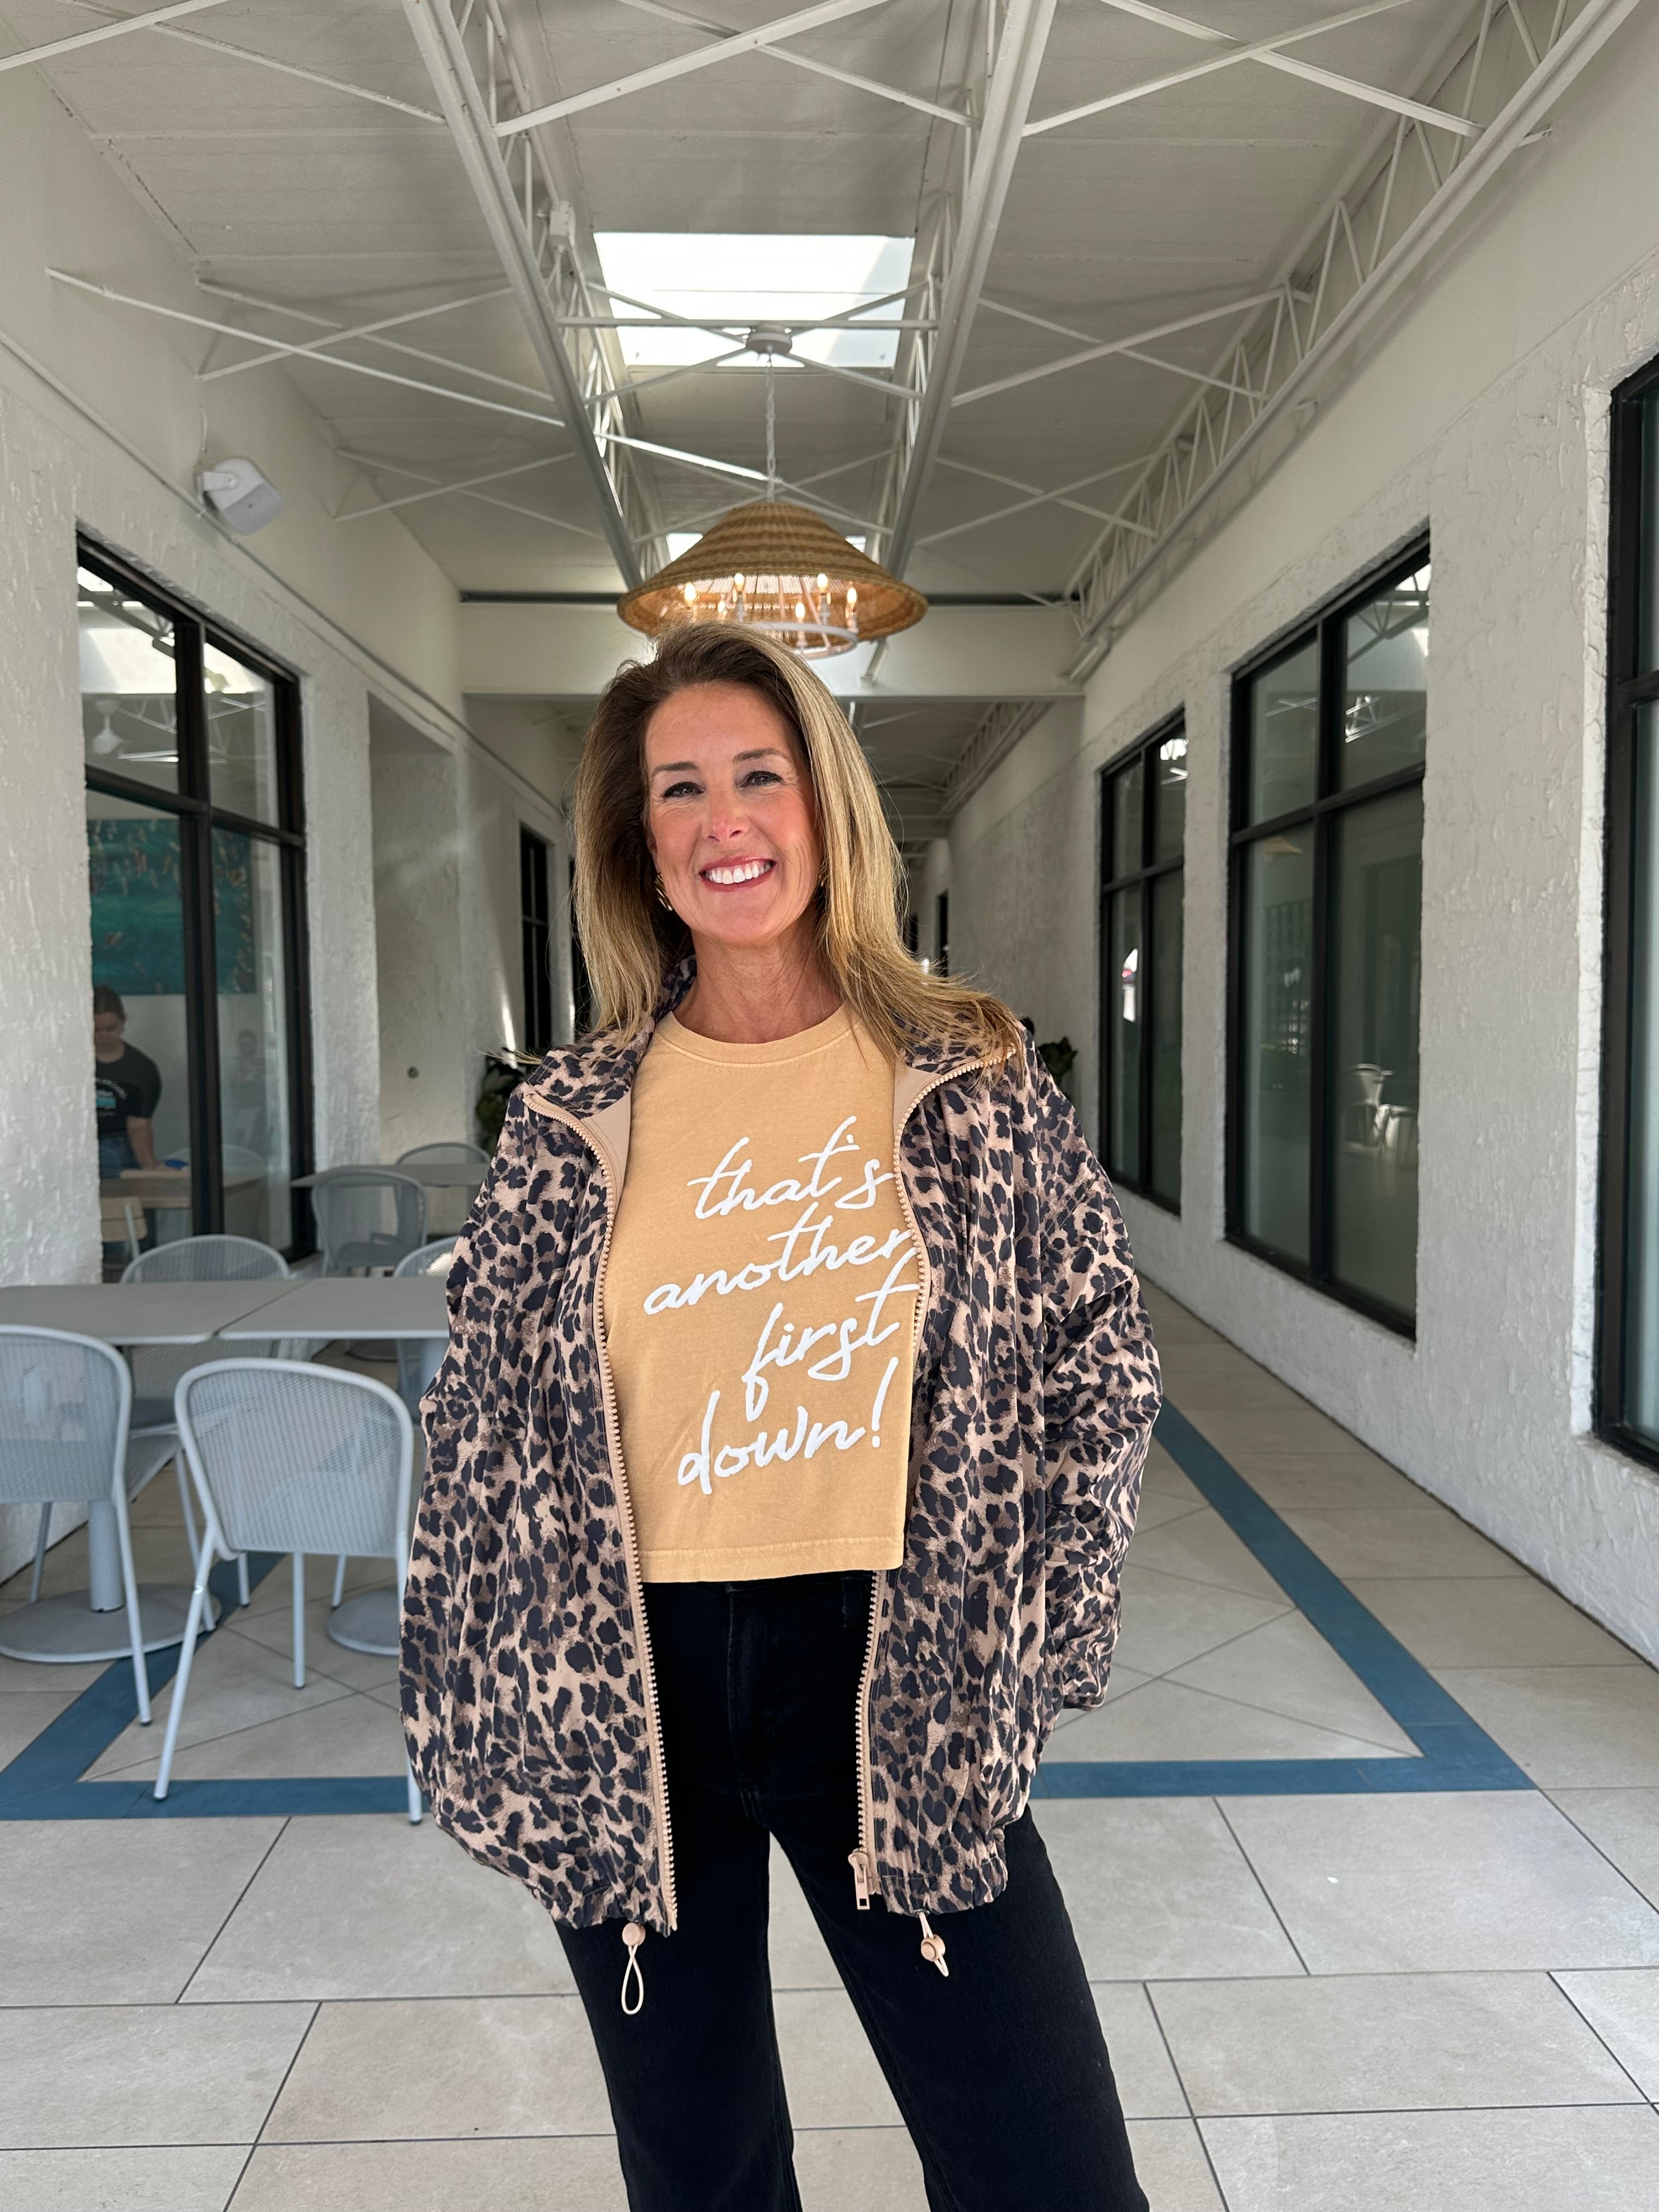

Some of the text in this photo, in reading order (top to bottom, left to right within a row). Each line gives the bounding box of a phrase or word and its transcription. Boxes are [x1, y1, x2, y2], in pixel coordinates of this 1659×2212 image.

[687, 1115, 895, 1220] that's
[644, 1202, 913, 1316] another
[742, 1246, 920, 1422] first
[677, 1357, 899, 1495] down!
